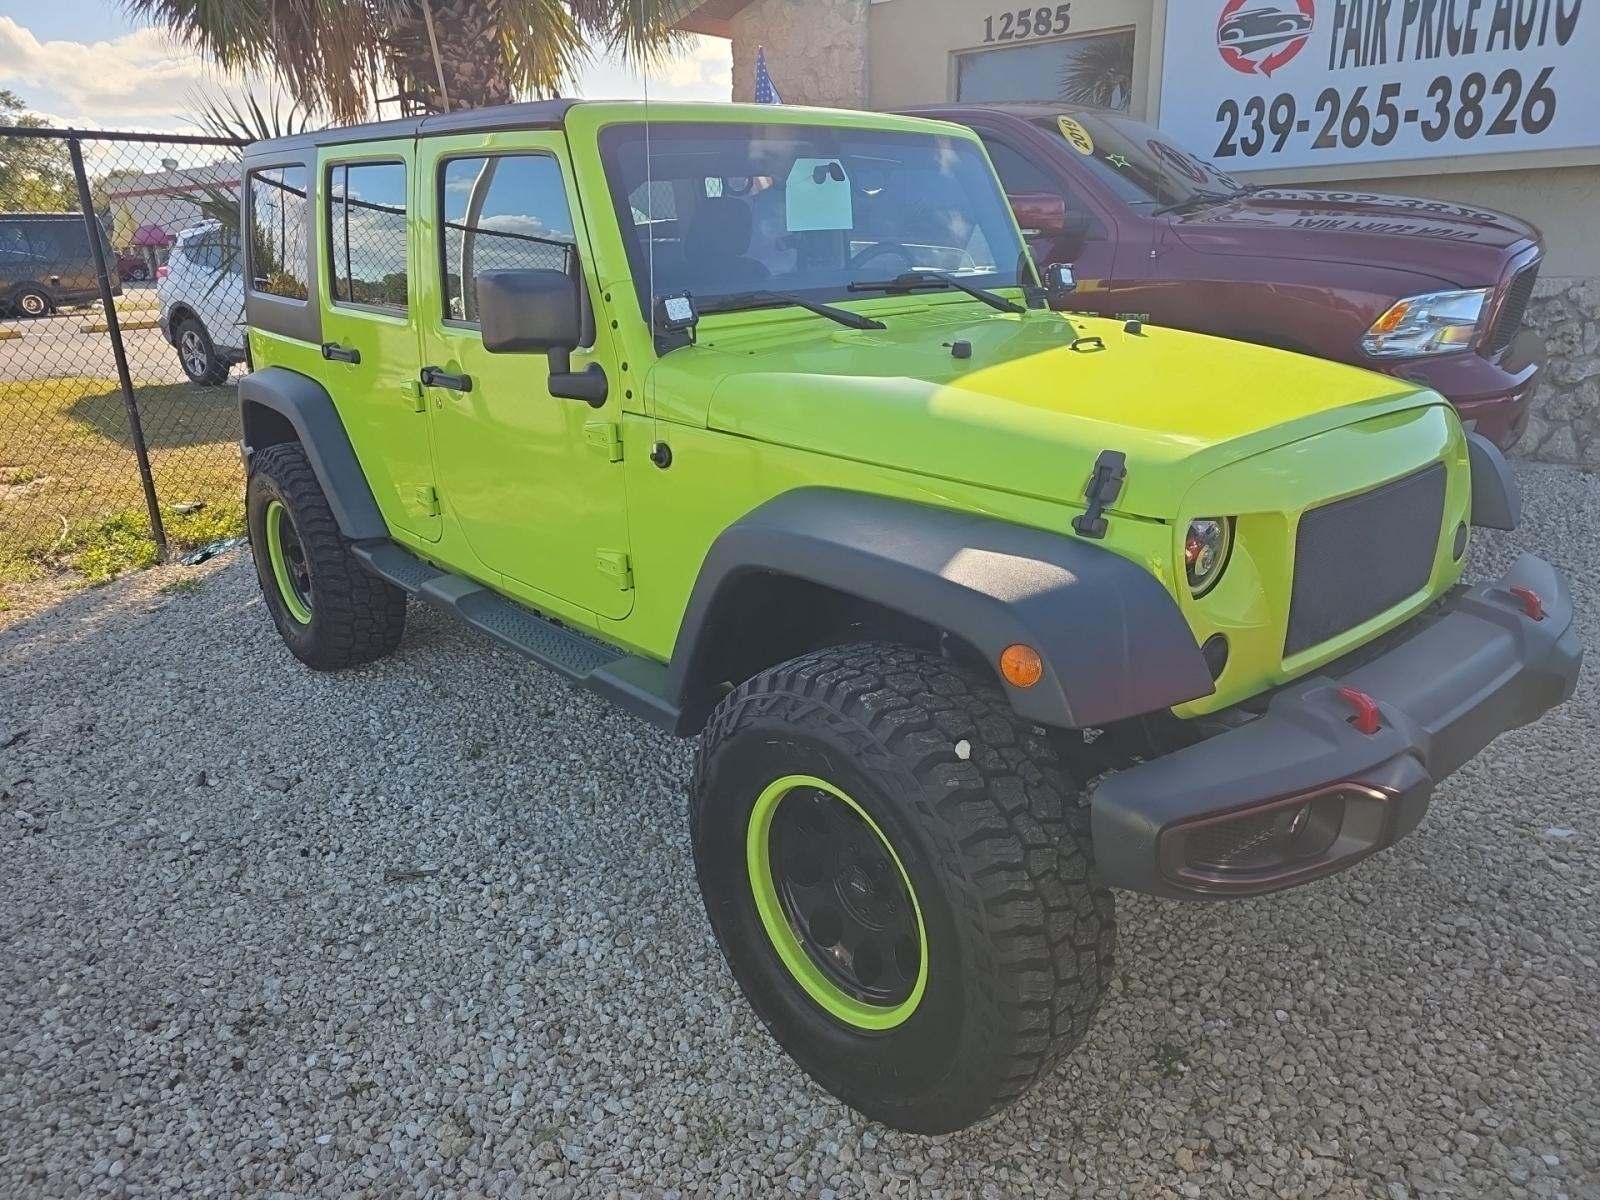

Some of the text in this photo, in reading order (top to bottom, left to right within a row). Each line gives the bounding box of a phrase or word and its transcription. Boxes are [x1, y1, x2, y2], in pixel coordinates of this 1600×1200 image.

[983, 3, 1071, 42] 12585
[1329, 0, 1393, 71] FAIR
[1213, 66, 1557, 158] 239-265-3826
